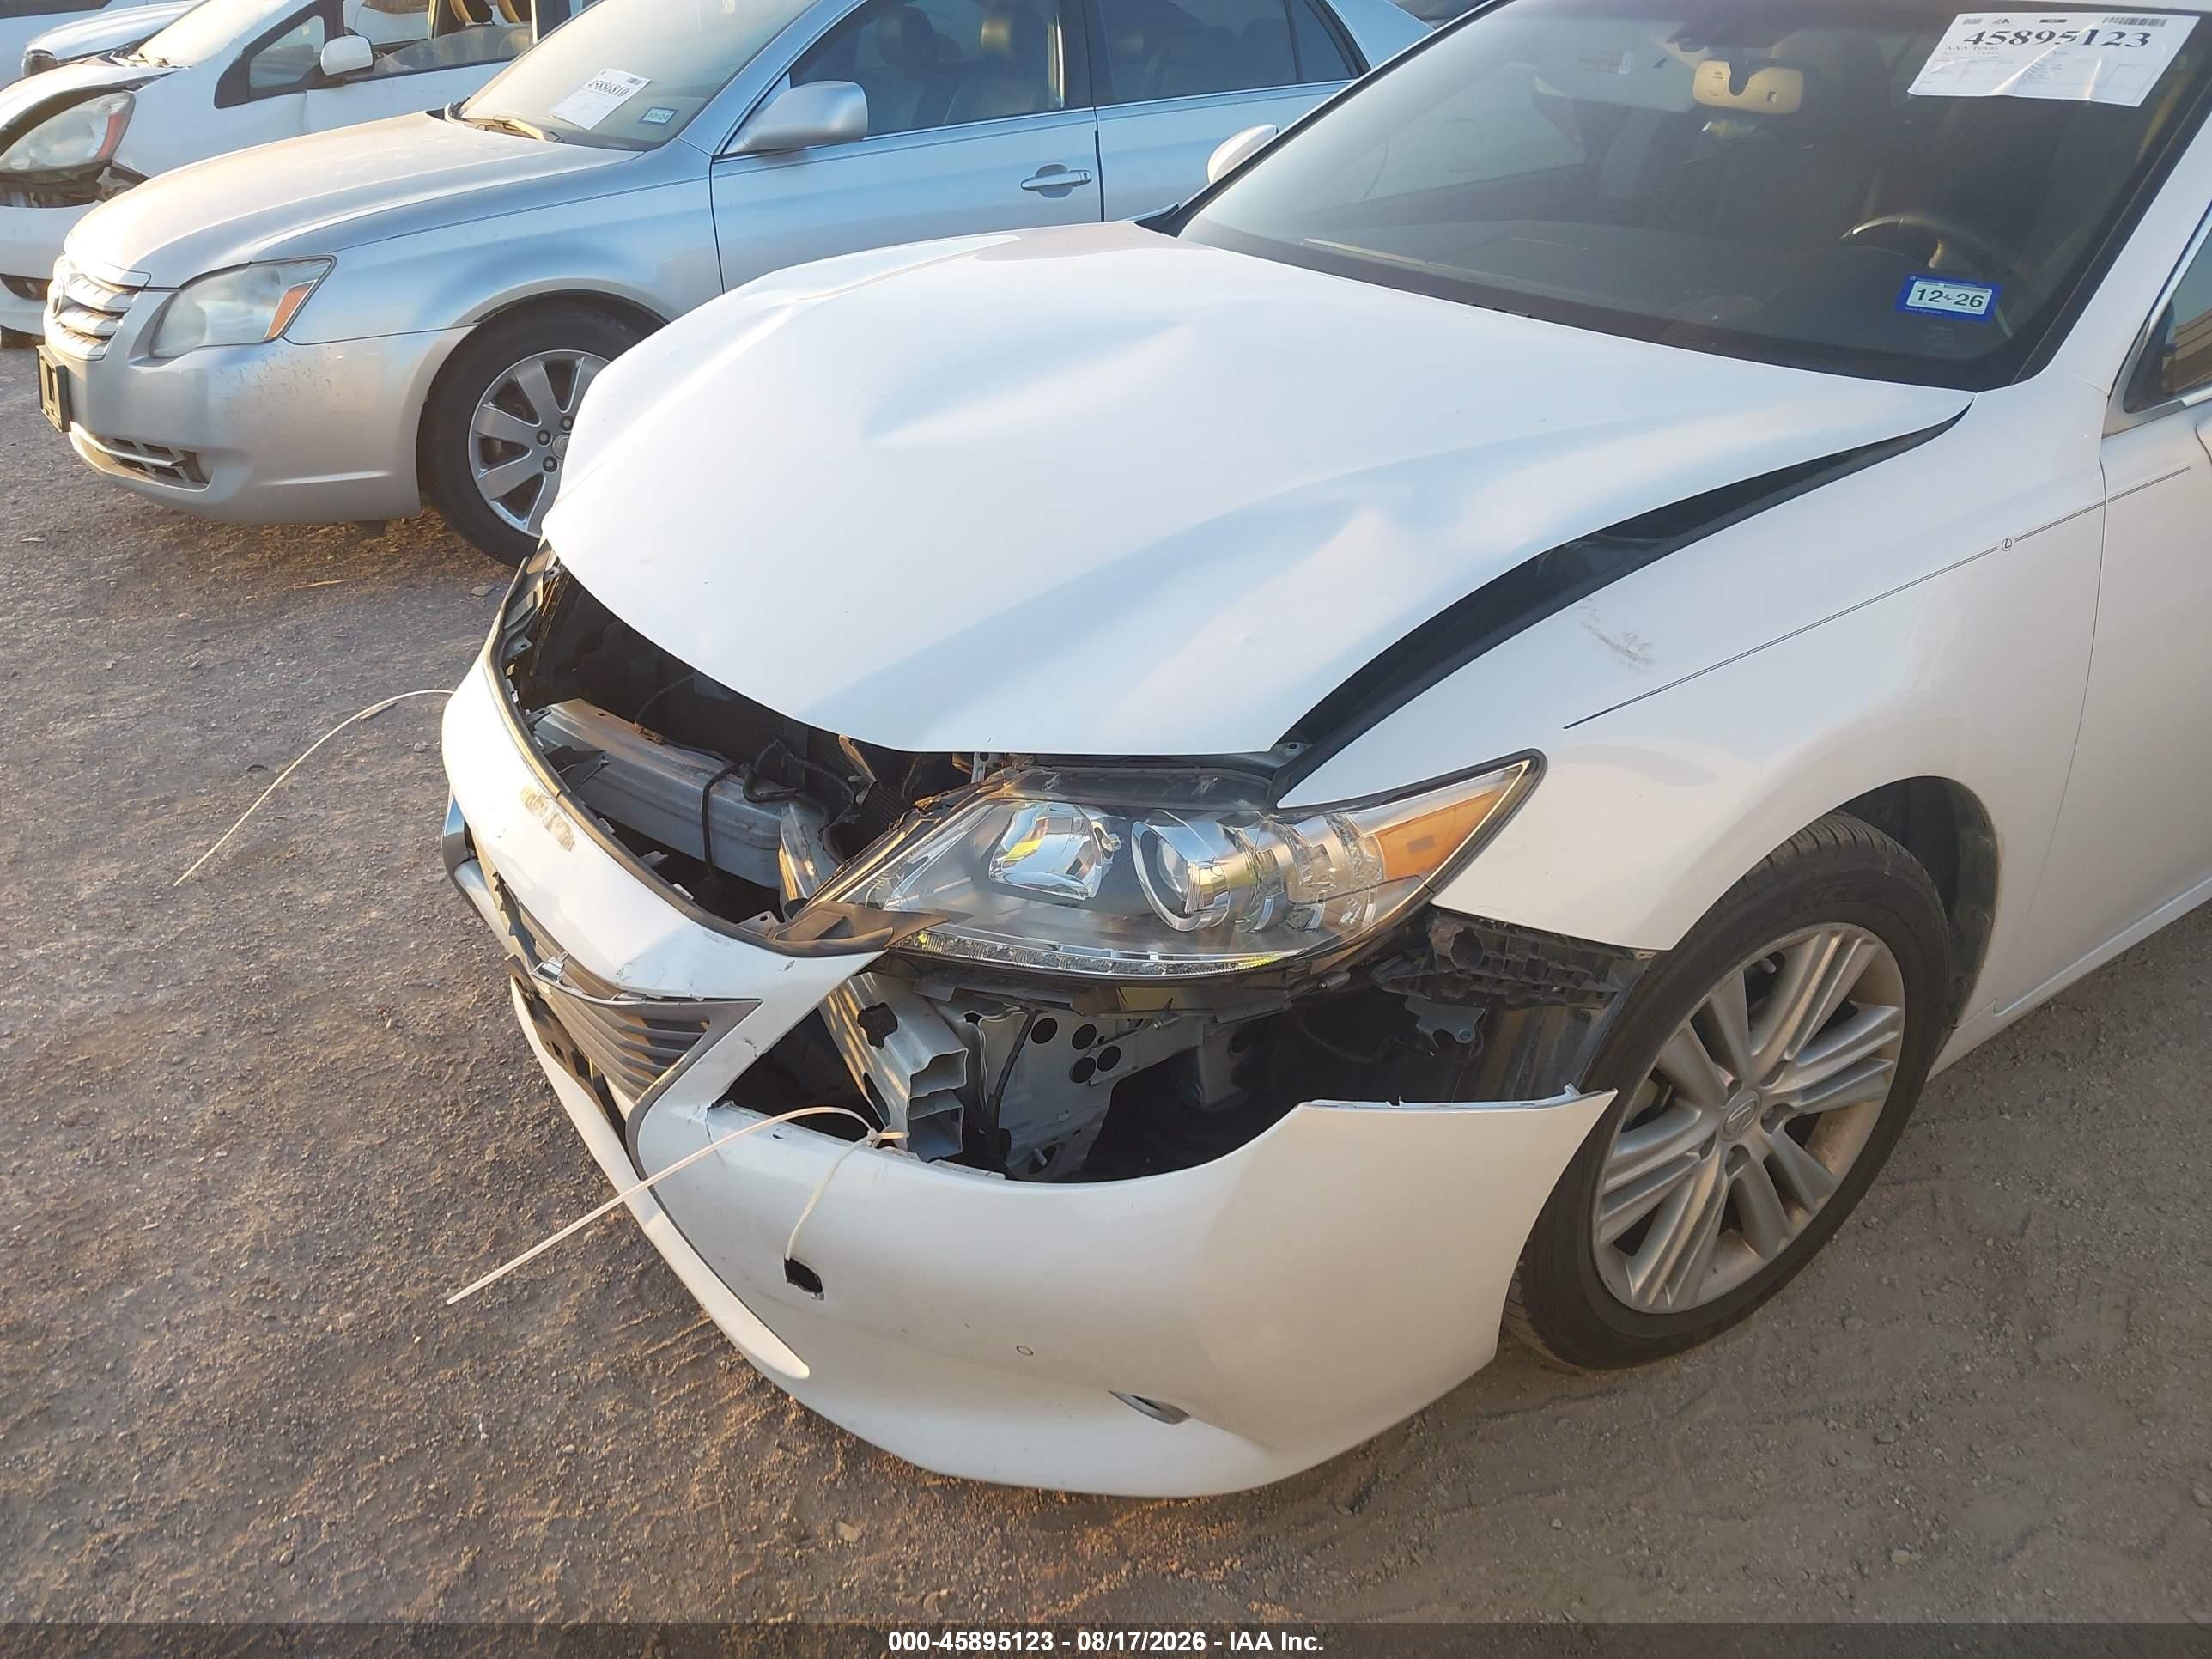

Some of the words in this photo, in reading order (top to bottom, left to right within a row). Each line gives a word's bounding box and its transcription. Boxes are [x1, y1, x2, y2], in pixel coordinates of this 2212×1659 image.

[1963, 29, 2151, 48] 45895123
[1916, 288, 1943, 303] 12
[1954, 293, 1985, 308] 26
